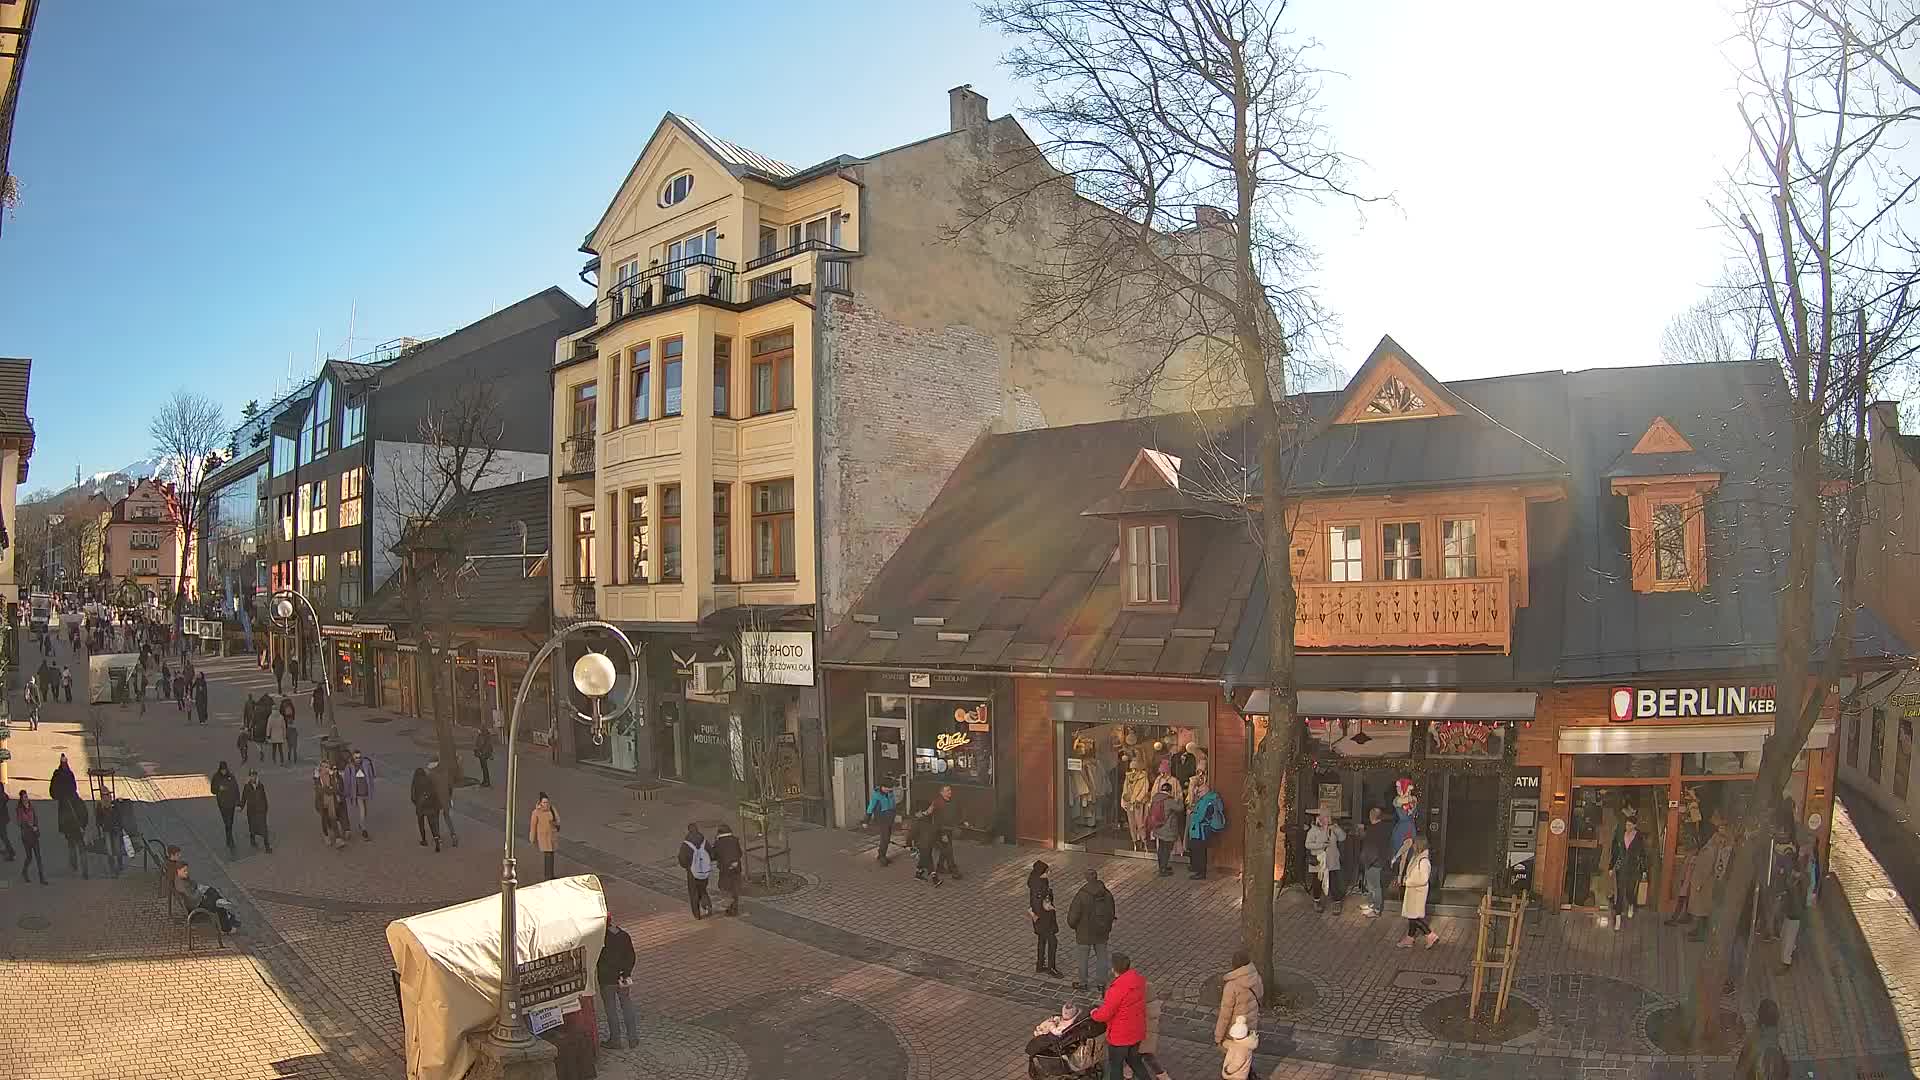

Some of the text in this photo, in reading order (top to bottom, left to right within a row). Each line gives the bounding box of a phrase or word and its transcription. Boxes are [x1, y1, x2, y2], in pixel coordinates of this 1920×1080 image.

[769, 645, 804, 657] PHOTO
[1637, 687, 1746, 717] BERLIN
[1514, 776, 1539, 787] ATM
